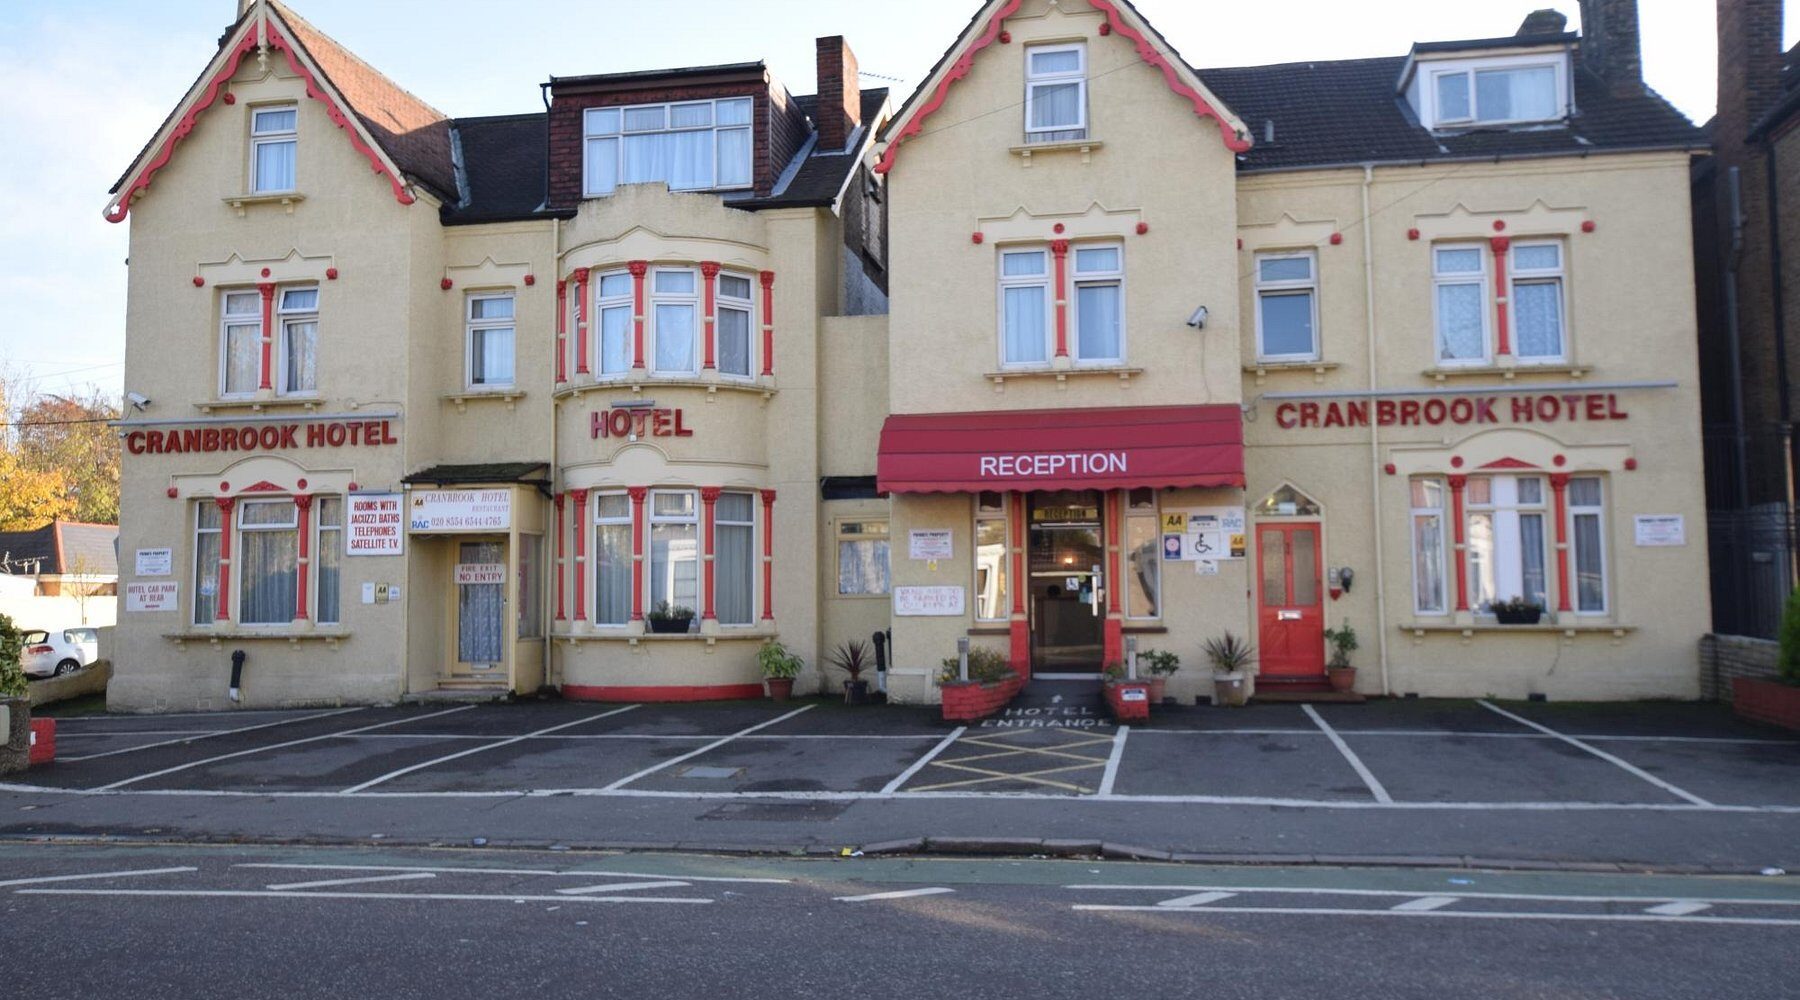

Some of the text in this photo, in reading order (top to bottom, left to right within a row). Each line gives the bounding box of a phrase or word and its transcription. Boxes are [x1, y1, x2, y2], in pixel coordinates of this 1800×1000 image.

[1275, 394, 1628, 429] CRANBROOK HOTEL
[591, 408, 693, 439] HOTEL
[127, 420, 398, 455] CRANBROOK HOTEL
[980, 453, 1127, 476] RECEPTION
[425, 491, 508, 503] CRANBROOK HOTEL
[354, 500, 397, 511] ROOMS WITH
[351, 513, 400, 524] JACUZZI BATHS
[1167, 515, 1182, 526] AA
[412, 520, 429, 529] RAC
[355, 526, 396, 536] TELEPHONES
[351, 539, 385, 549] SATELLITE
[460, 572, 503, 581] NO ENTRY
[1005, 707, 1094, 716] HOTEL
[980, 718, 1111, 728] ENTRANCE
